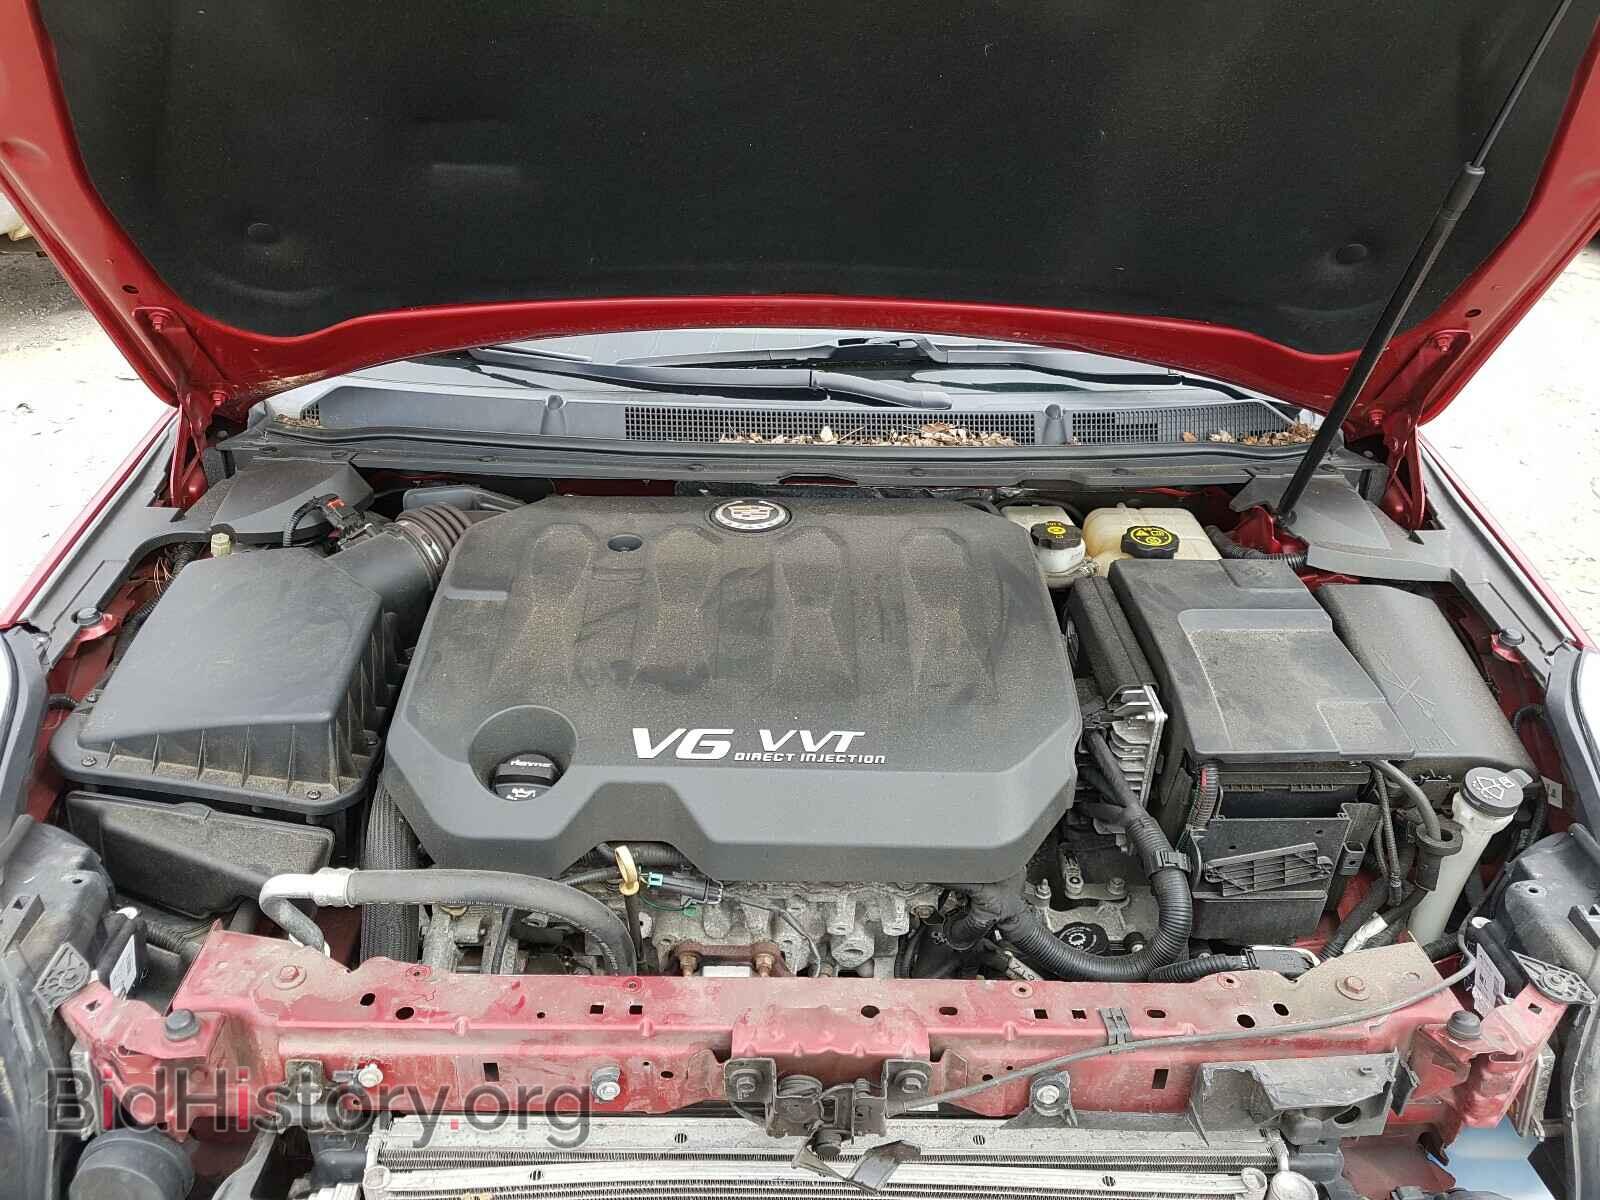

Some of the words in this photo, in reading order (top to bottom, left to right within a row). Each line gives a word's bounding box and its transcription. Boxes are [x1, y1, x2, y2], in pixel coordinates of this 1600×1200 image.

[632, 727, 735, 760] V6
[759, 729, 866, 752] VVT
[734, 752, 795, 762] DIRECT
